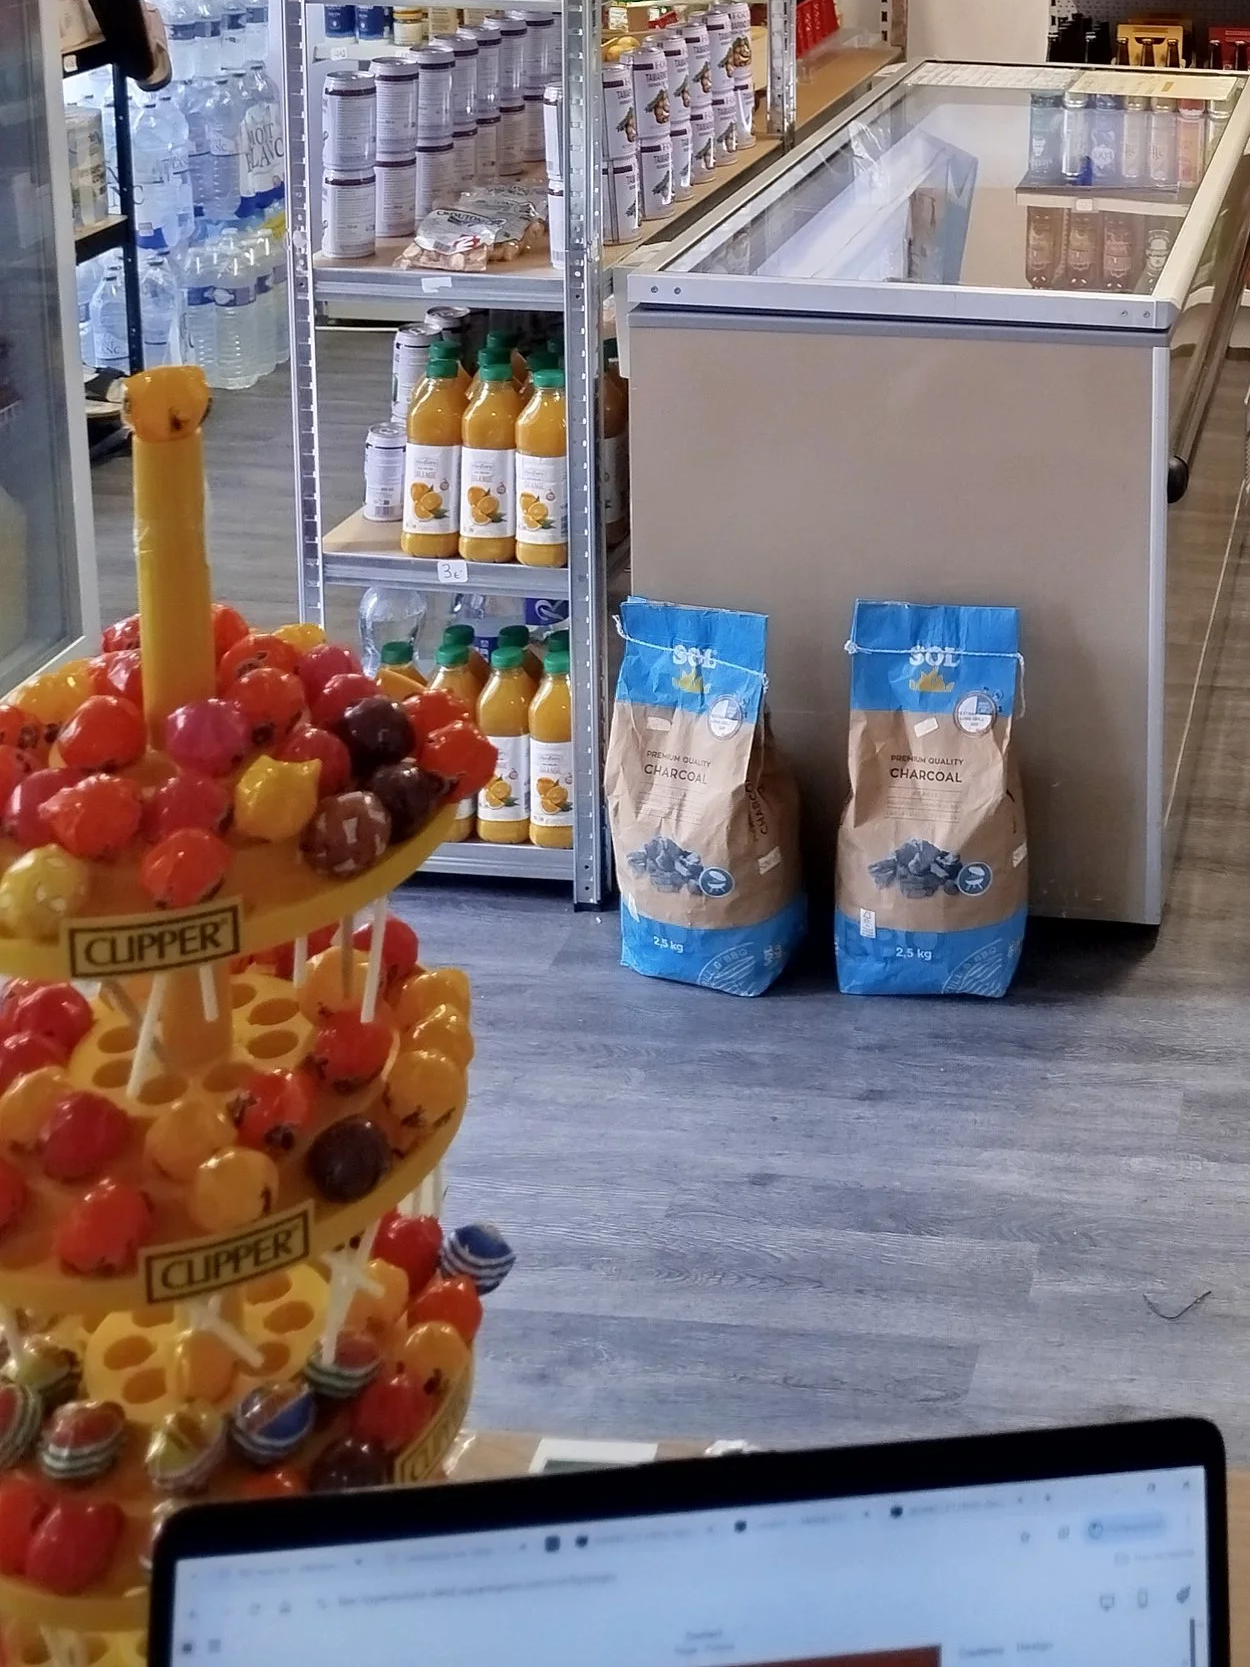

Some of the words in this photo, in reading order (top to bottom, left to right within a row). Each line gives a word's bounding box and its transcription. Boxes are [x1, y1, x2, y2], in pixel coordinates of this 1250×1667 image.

[672, 644, 717, 669] SOL
[909, 644, 960, 668] SOL
[646, 749, 681, 763] PREMIUM
[682, 755, 712, 768] QUALITY
[890, 754, 926, 764] PREMIUM
[927, 757, 965, 766] QUALITY
[644, 763, 708, 785] CHARCOAL
[889, 768, 963, 783] CHARCOAL
[83, 923, 222, 968] CLIPPER
[653, 935, 668, 949] 2,5
[670, 942, 684, 954] kg
[895, 946, 914, 959] 2,5
[917, 948, 933, 961] kg
[160, 1235, 295, 1291] CLIPPER
